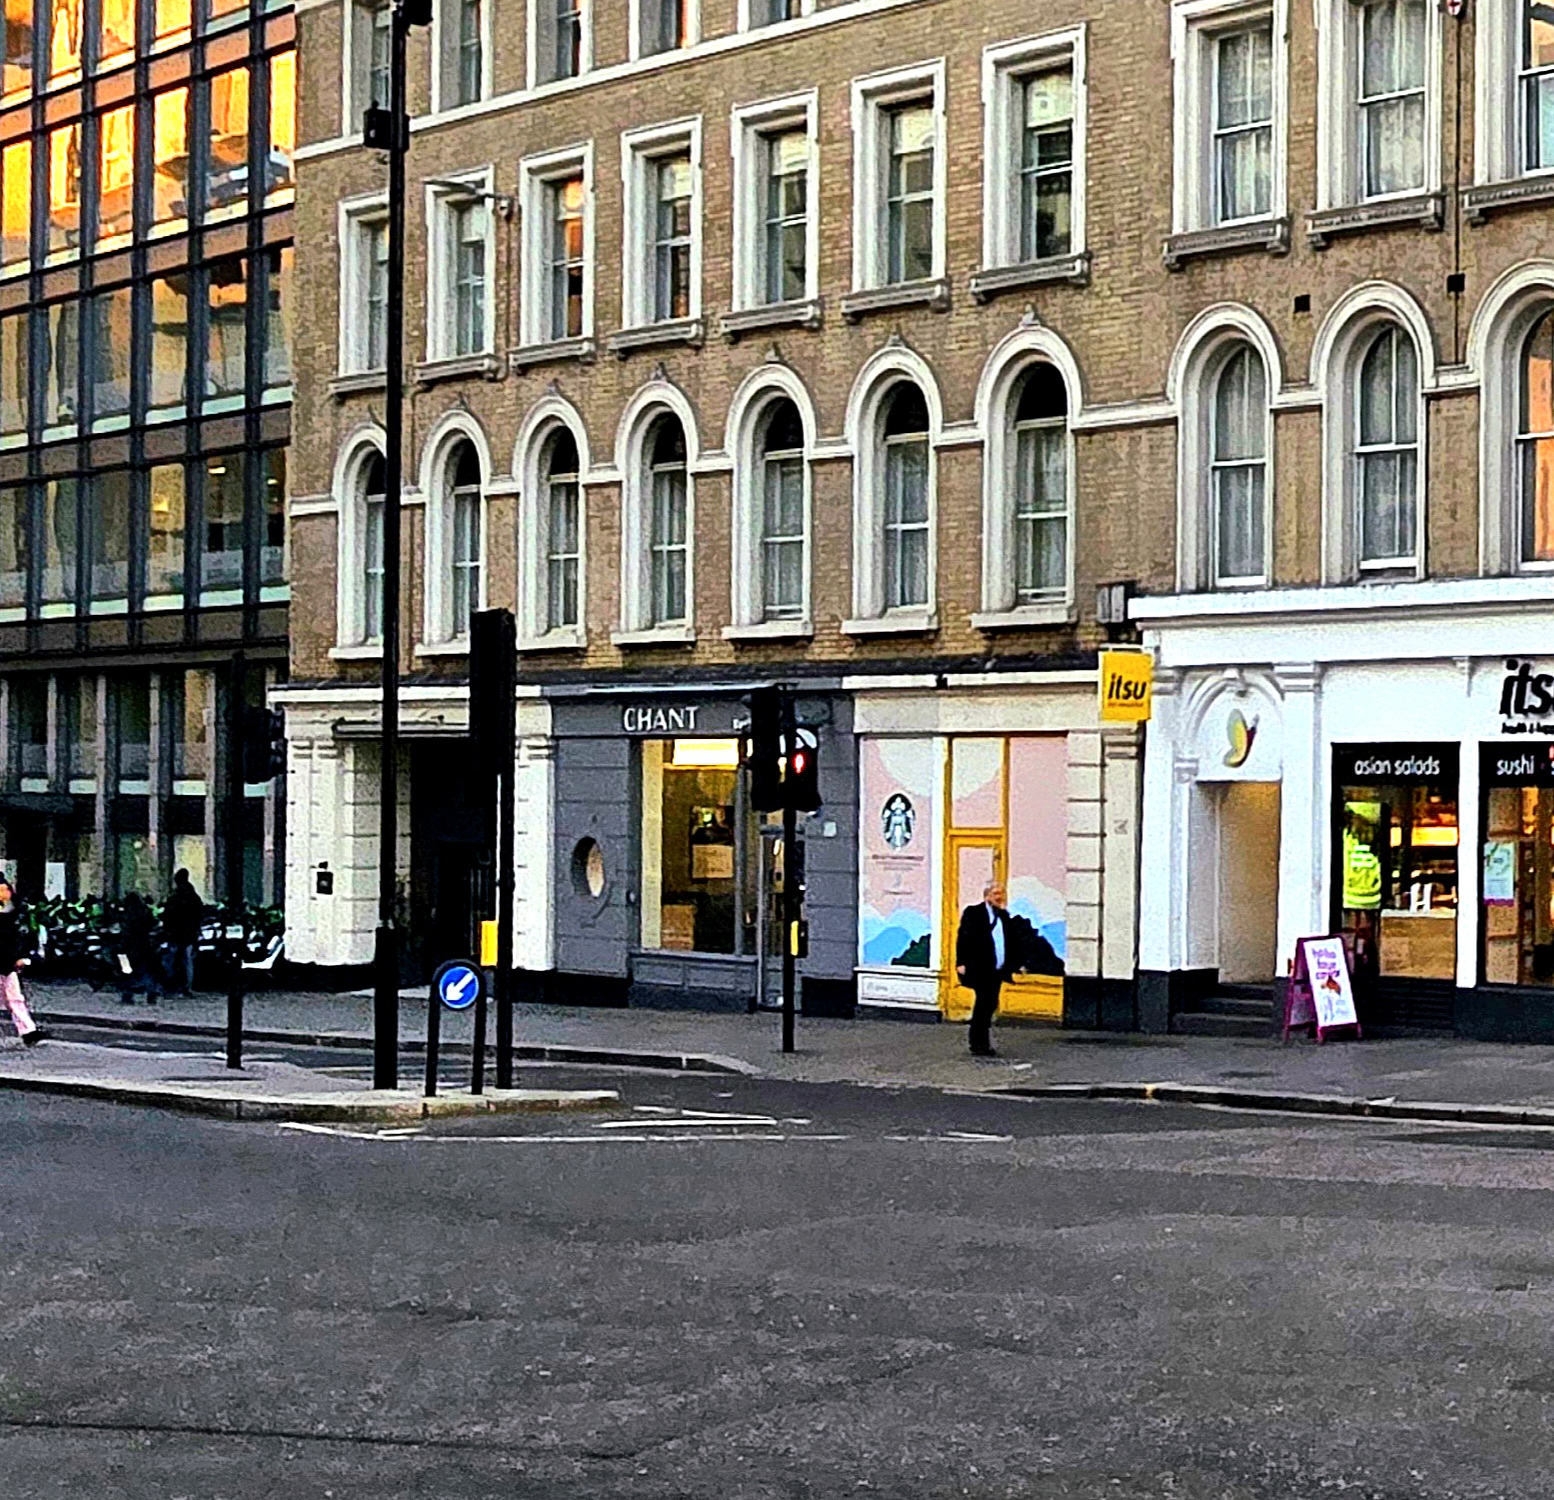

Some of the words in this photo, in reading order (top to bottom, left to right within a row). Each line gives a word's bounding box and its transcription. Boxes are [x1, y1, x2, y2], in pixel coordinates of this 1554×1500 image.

[1107, 672, 1148, 701] itsu
[623, 705, 700, 732] CHANT
[1354, 755, 1392, 775] asian
[1394, 754, 1441, 776] salads
[1496, 753, 1535, 776] sushi
